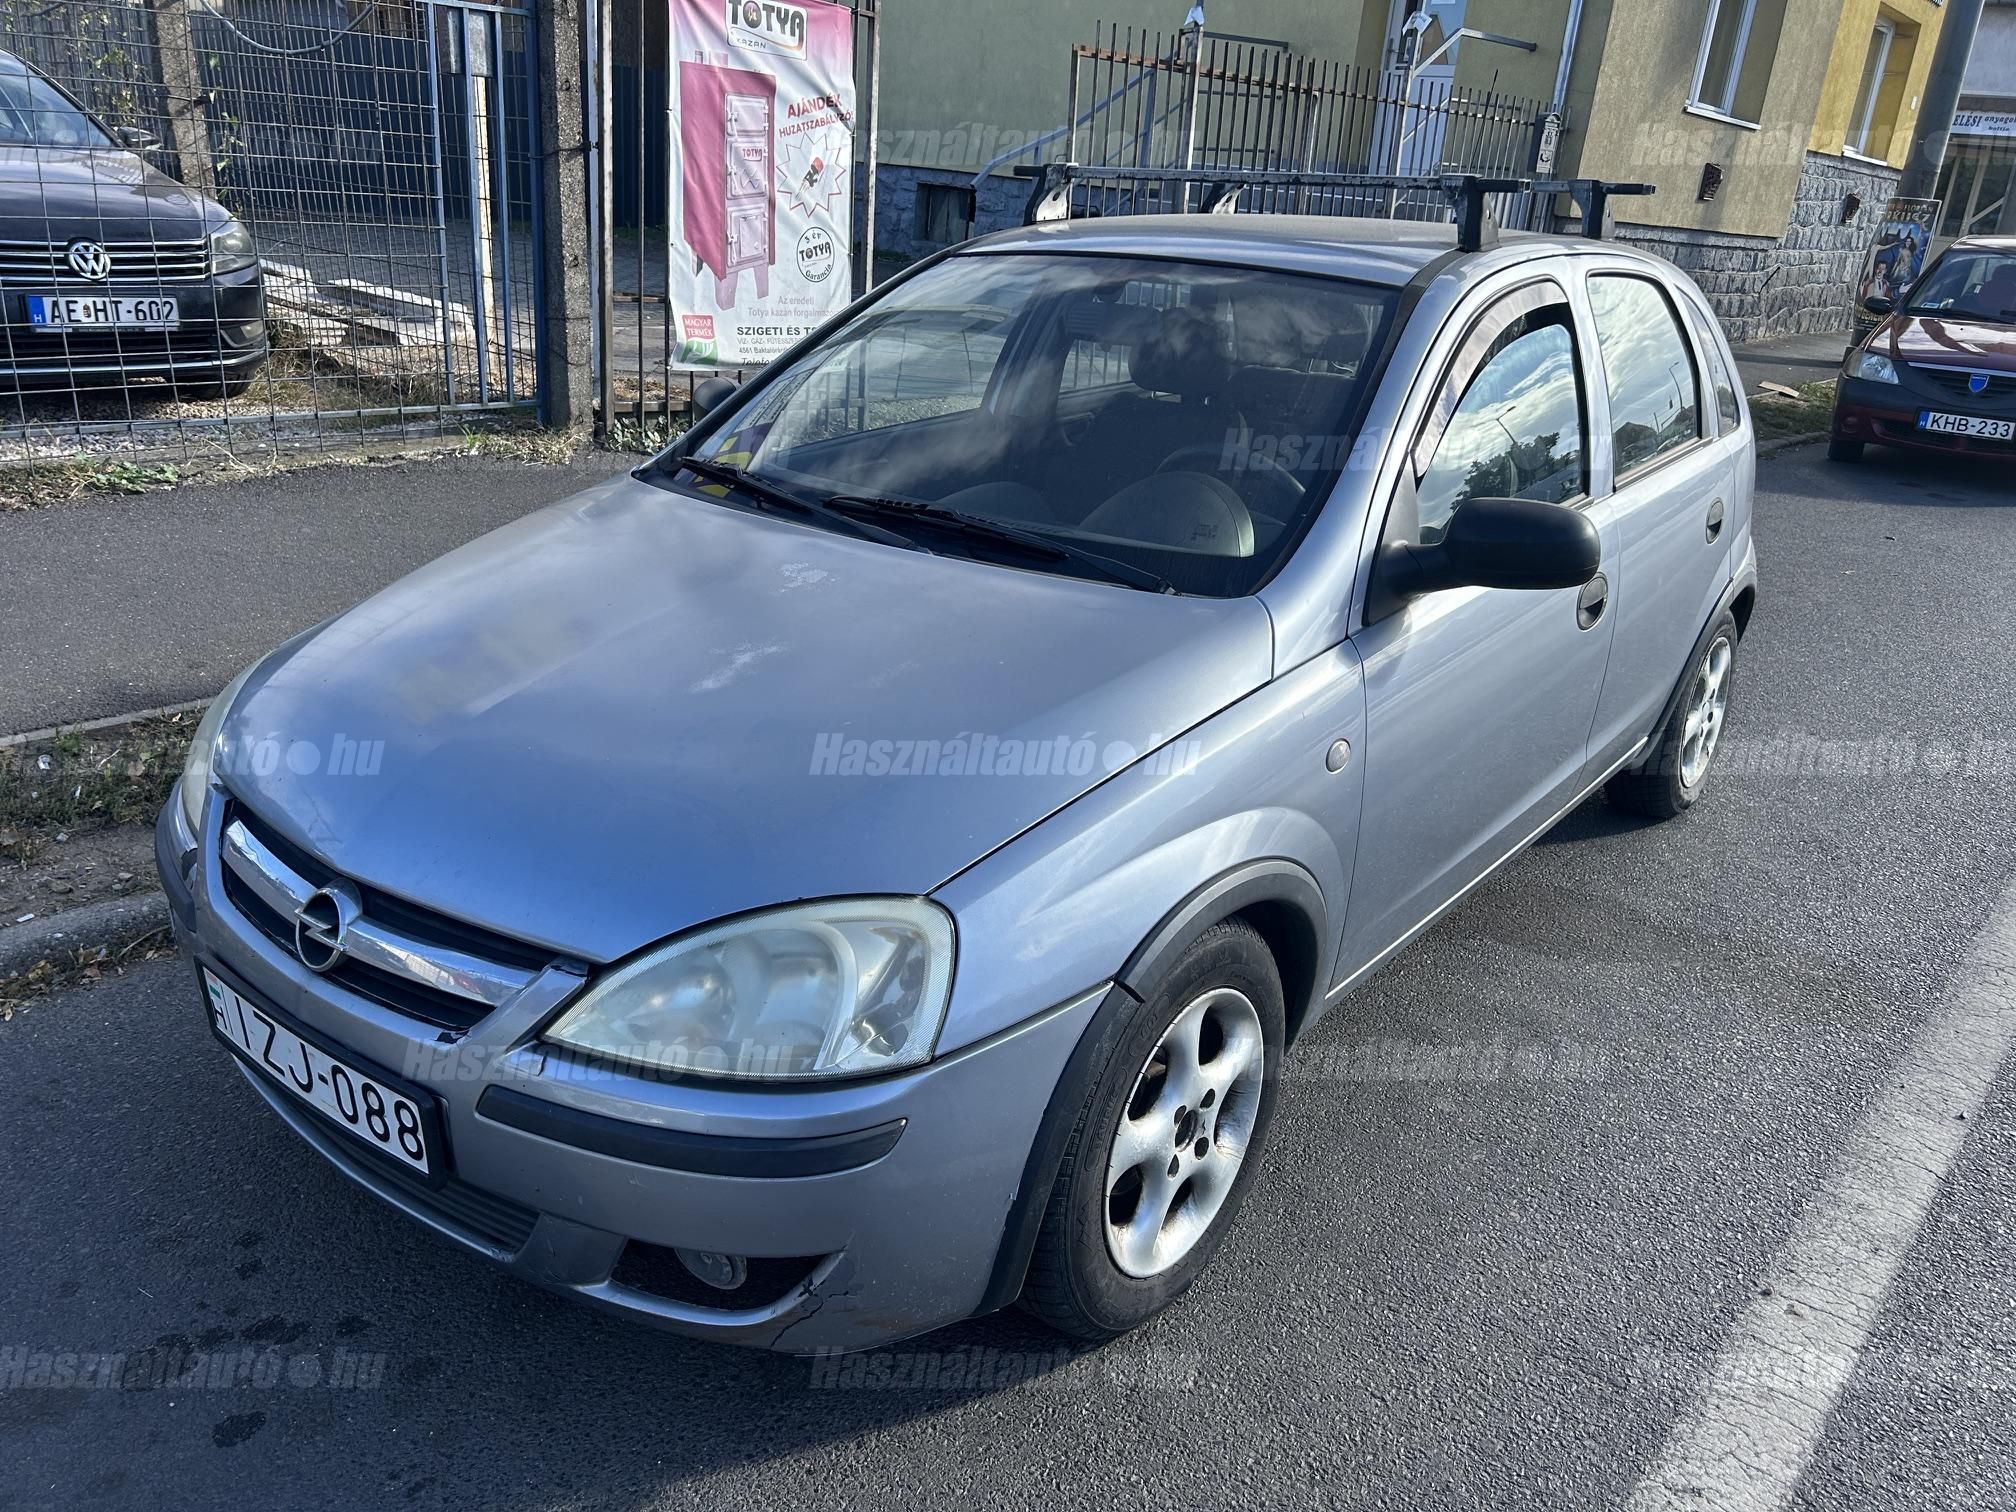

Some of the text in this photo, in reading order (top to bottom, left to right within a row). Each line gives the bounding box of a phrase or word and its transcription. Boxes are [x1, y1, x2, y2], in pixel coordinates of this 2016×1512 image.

[729, 0, 804, 42] TOTYA
[787, 93, 842, 118] AJÁNDÉK
[1952, 112, 1982, 127] ELÉSI
[799, 241, 831, 261] TOTYA
[805, 264, 831, 280] Garancia
[778, 296, 814, 304] Az eredeti
[748, 307, 769, 318] Totya
[770, 307, 792, 316] kazán
[684, 318, 711, 326] MAGYAR
[737, 327, 783, 336] SZIGETI
[787, 325, 801, 336] ÉS
[1930, 414, 2011, 437] KHB-233
[211, 999, 228, 1030] H
[235, 995, 424, 1162] IZJ-088
